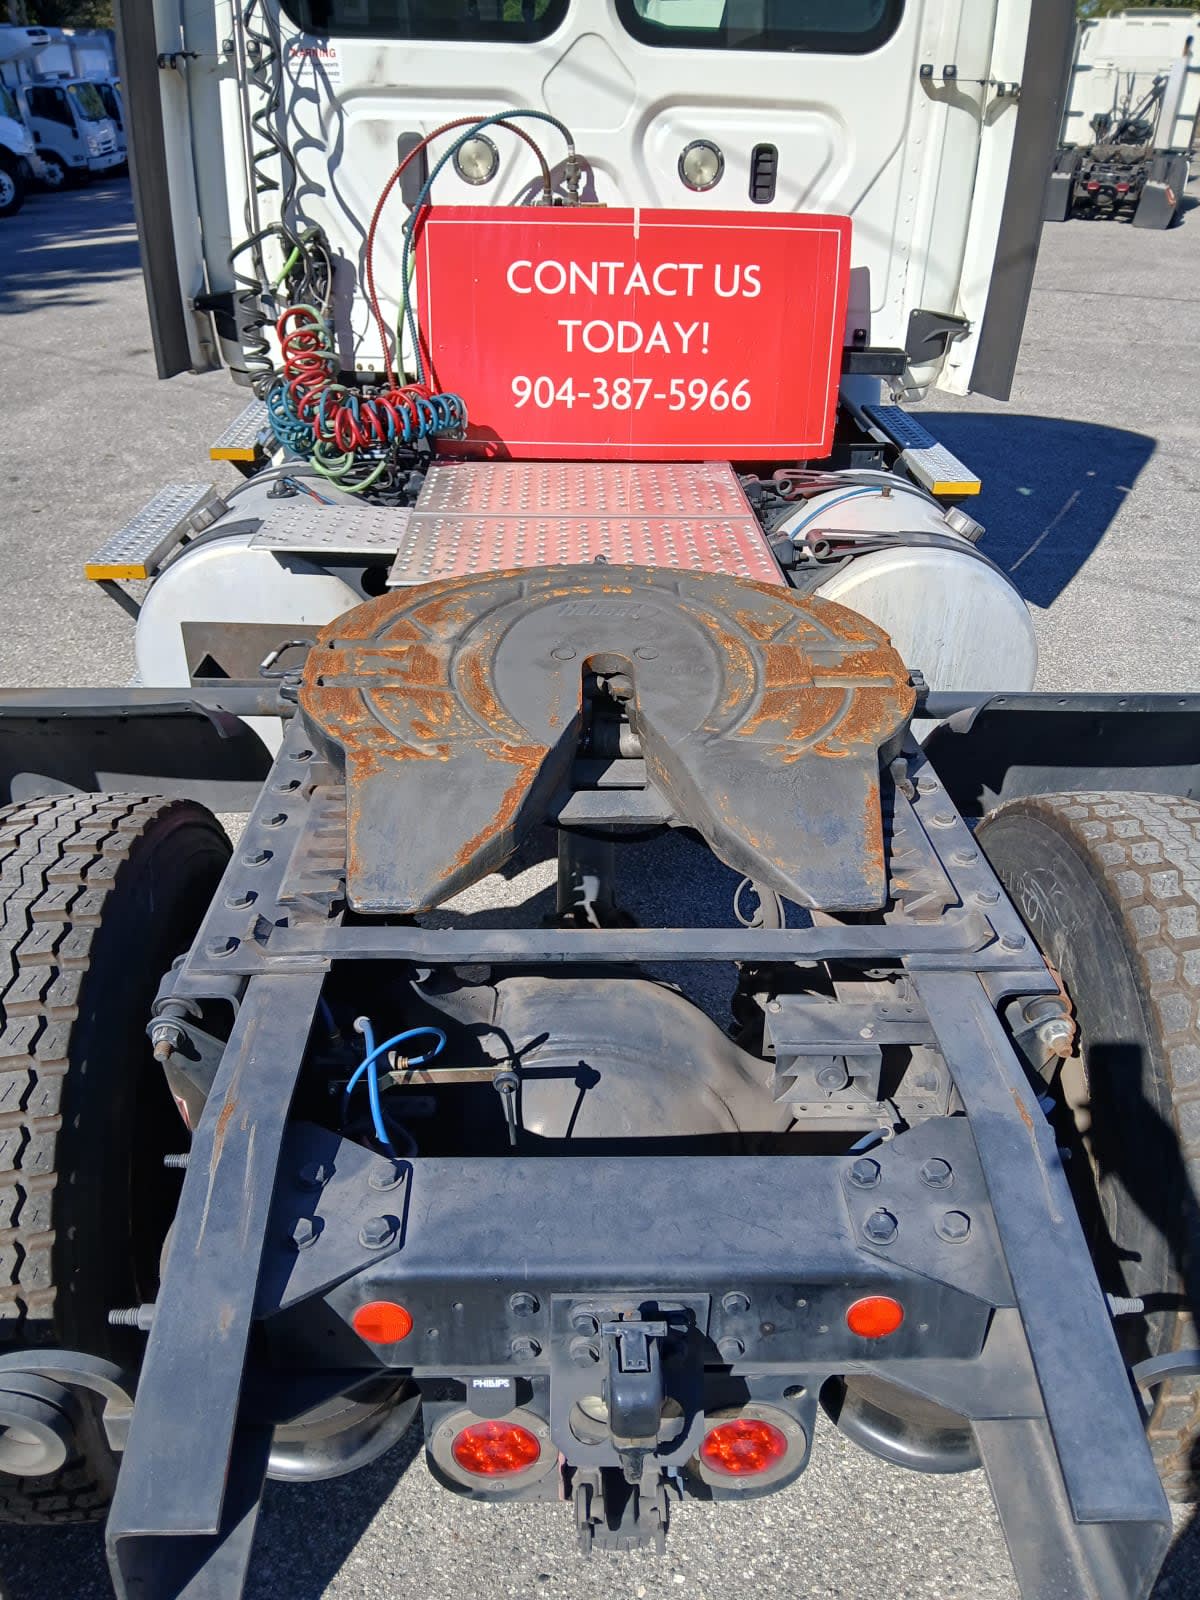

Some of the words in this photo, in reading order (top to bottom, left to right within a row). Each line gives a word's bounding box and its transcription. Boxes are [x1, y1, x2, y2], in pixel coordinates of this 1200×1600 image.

[506, 260, 704, 297] CONTACT
[714, 263, 761, 298] US
[557, 319, 709, 354] TODAY!
[511, 375, 752, 411] 904-387-5966
